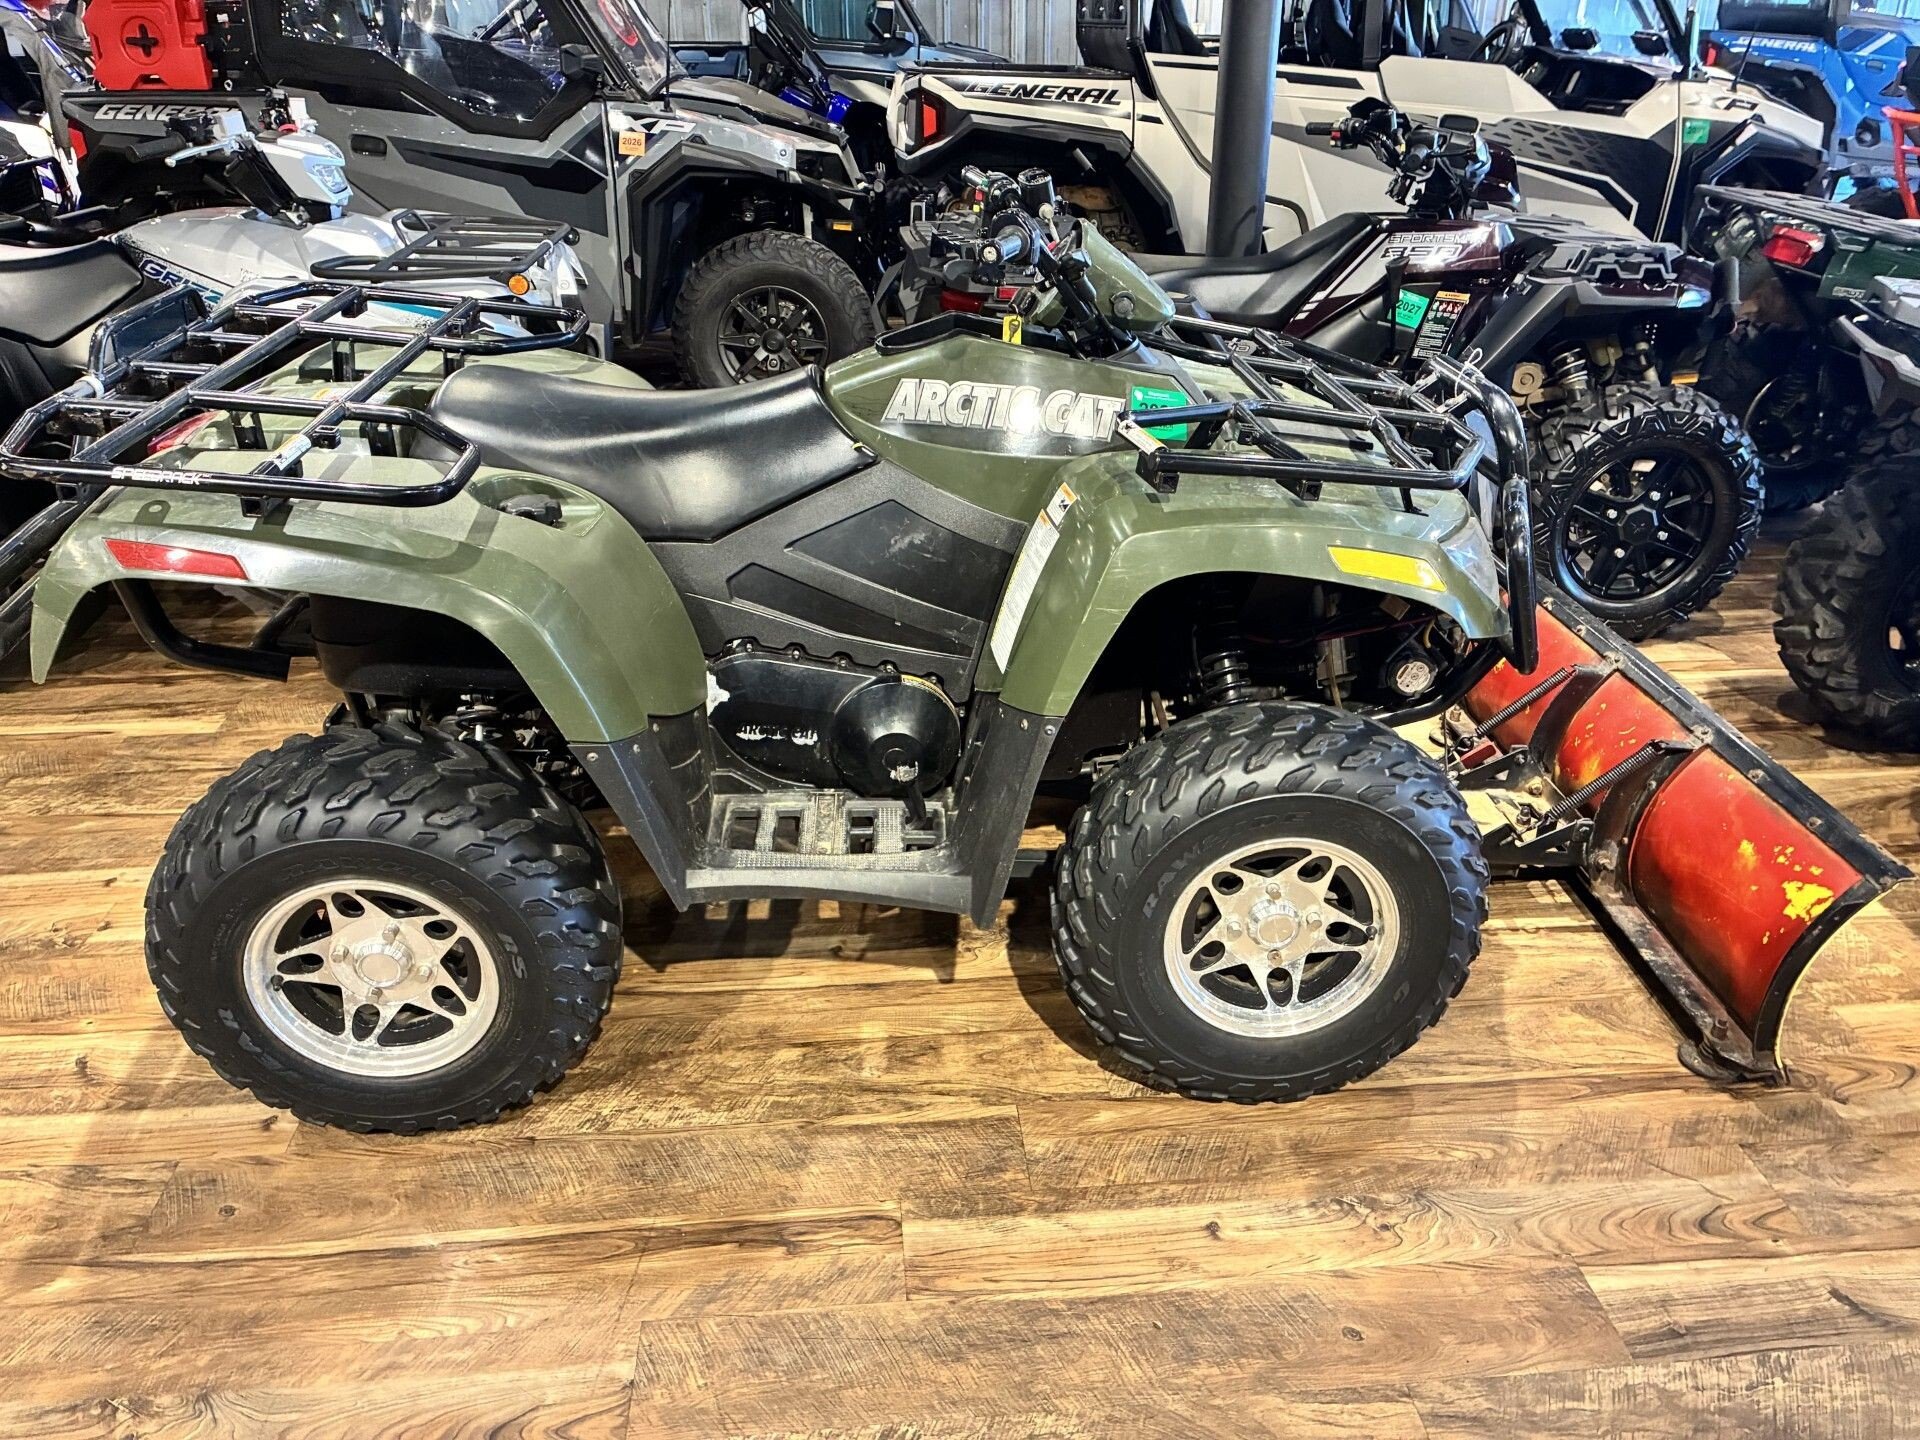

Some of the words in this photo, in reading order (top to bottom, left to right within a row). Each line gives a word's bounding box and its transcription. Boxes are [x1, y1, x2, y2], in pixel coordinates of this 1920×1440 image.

[1737, 36, 1817, 53] GENERAL
[965, 83, 1121, 106] GENERAL
[94, 104, 241, 121] GENE
[622, 137, 642, 146] 2026
[1388, 232, 1480, 244] SPORTSM
[1396, 299, 1422, 315] 2027
[880, 378, 1041, 432] ARCTIC
[1041, 389, 1127, 442] CAT
[735, 724, 787, 741] ARC
